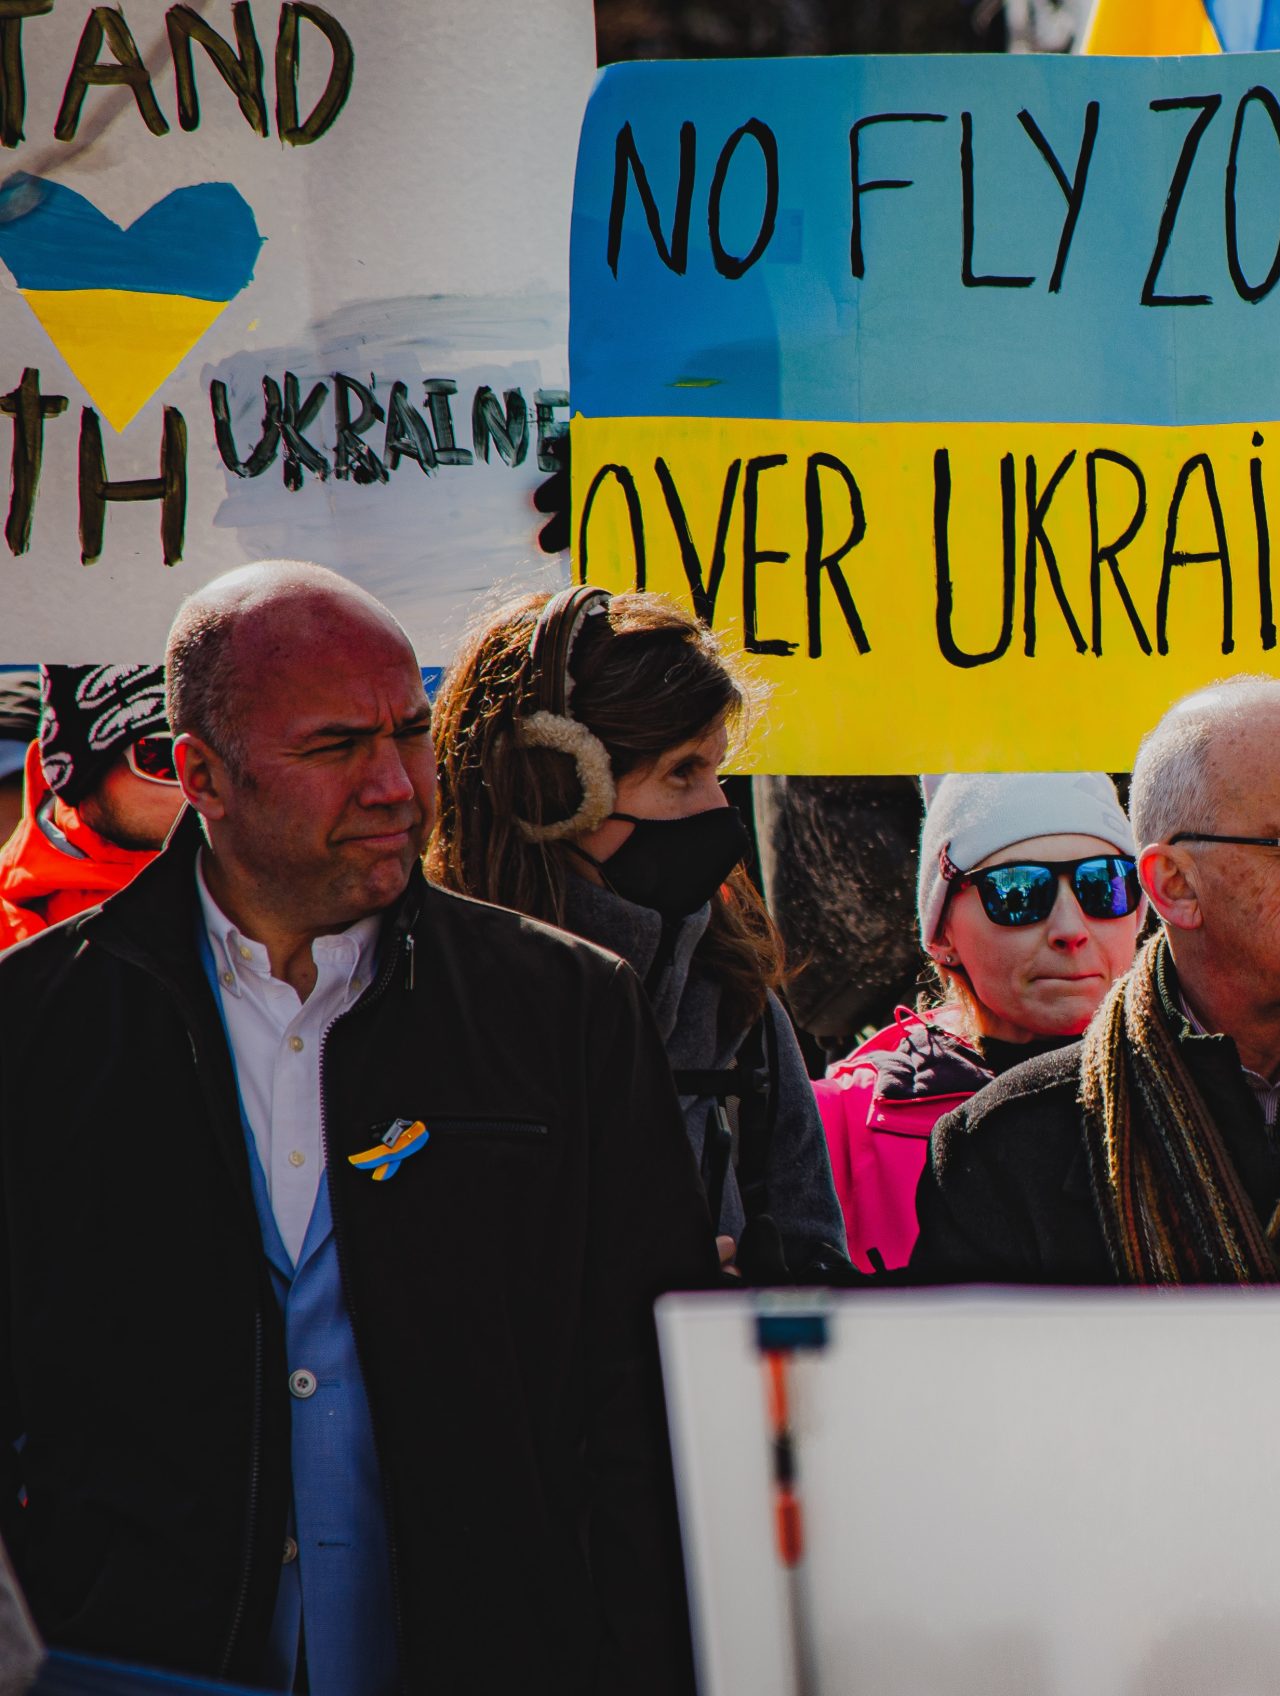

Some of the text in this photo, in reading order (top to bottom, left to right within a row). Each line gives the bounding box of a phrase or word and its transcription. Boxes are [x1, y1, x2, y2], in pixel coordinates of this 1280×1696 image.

[607, 117, 779, 280] NO
[849, 100, 1101, 294] FLY
[579, 453, 871, 658] OVER
